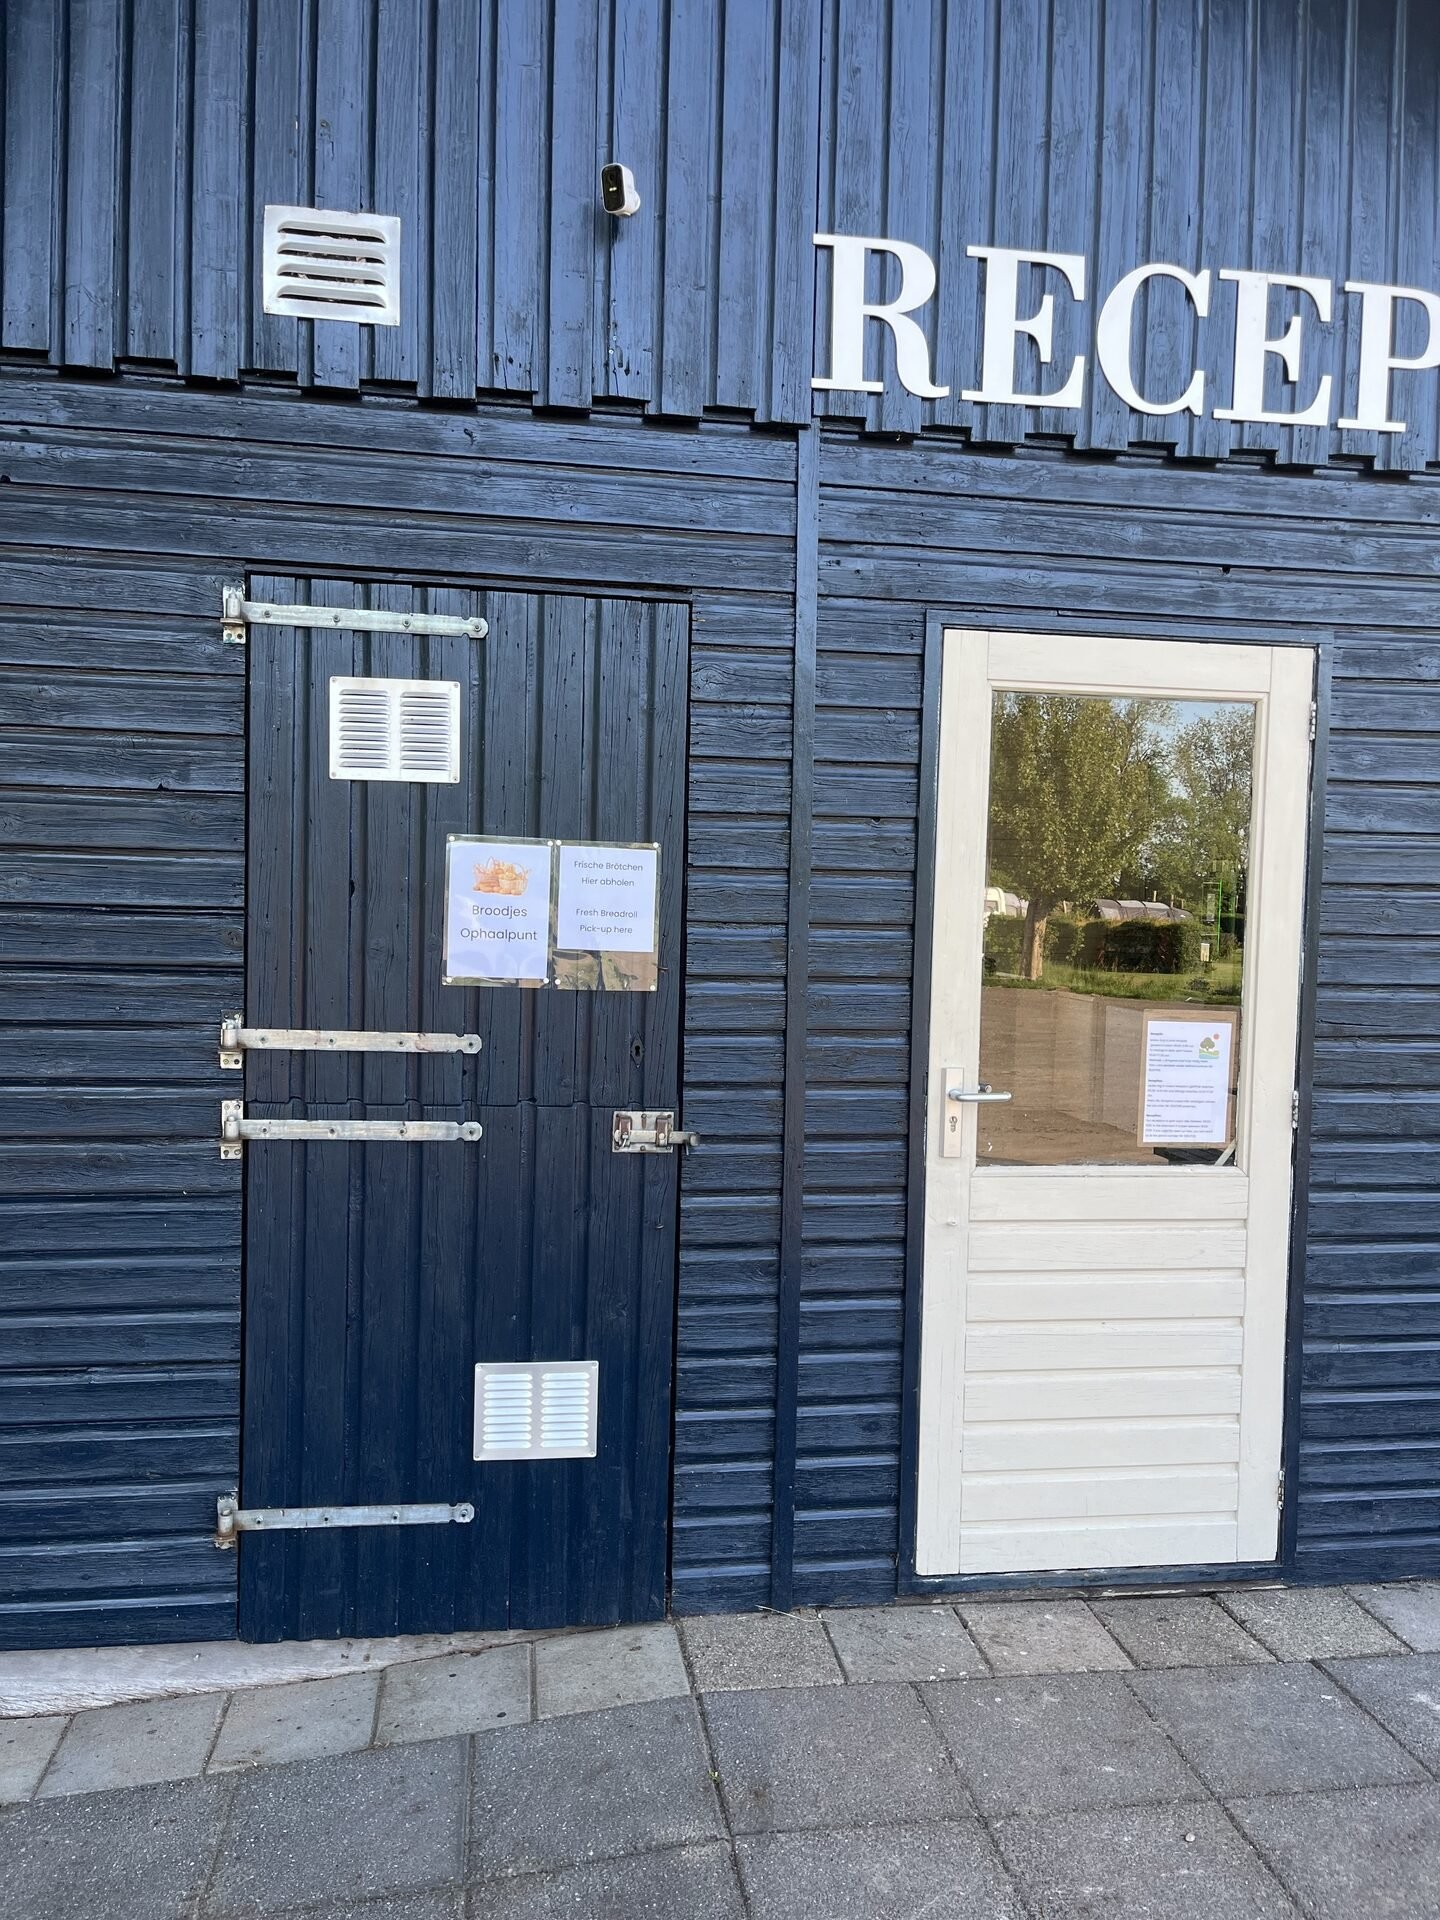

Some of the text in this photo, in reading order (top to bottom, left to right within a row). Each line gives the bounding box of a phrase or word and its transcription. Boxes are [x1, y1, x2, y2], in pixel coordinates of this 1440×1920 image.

[811, 233, 1440, 432] RECEP
[574, 861, 604, 870] Frische
[581, 877, 635, 886] Hier abholen
[472, 904, 528, 919] Broodjes
[576, 908, 638, 918] Fresh Breadroll
[579, 924, 633, 934] Pick-up here
[460, 927, 538, 942] Ophaalpunt
